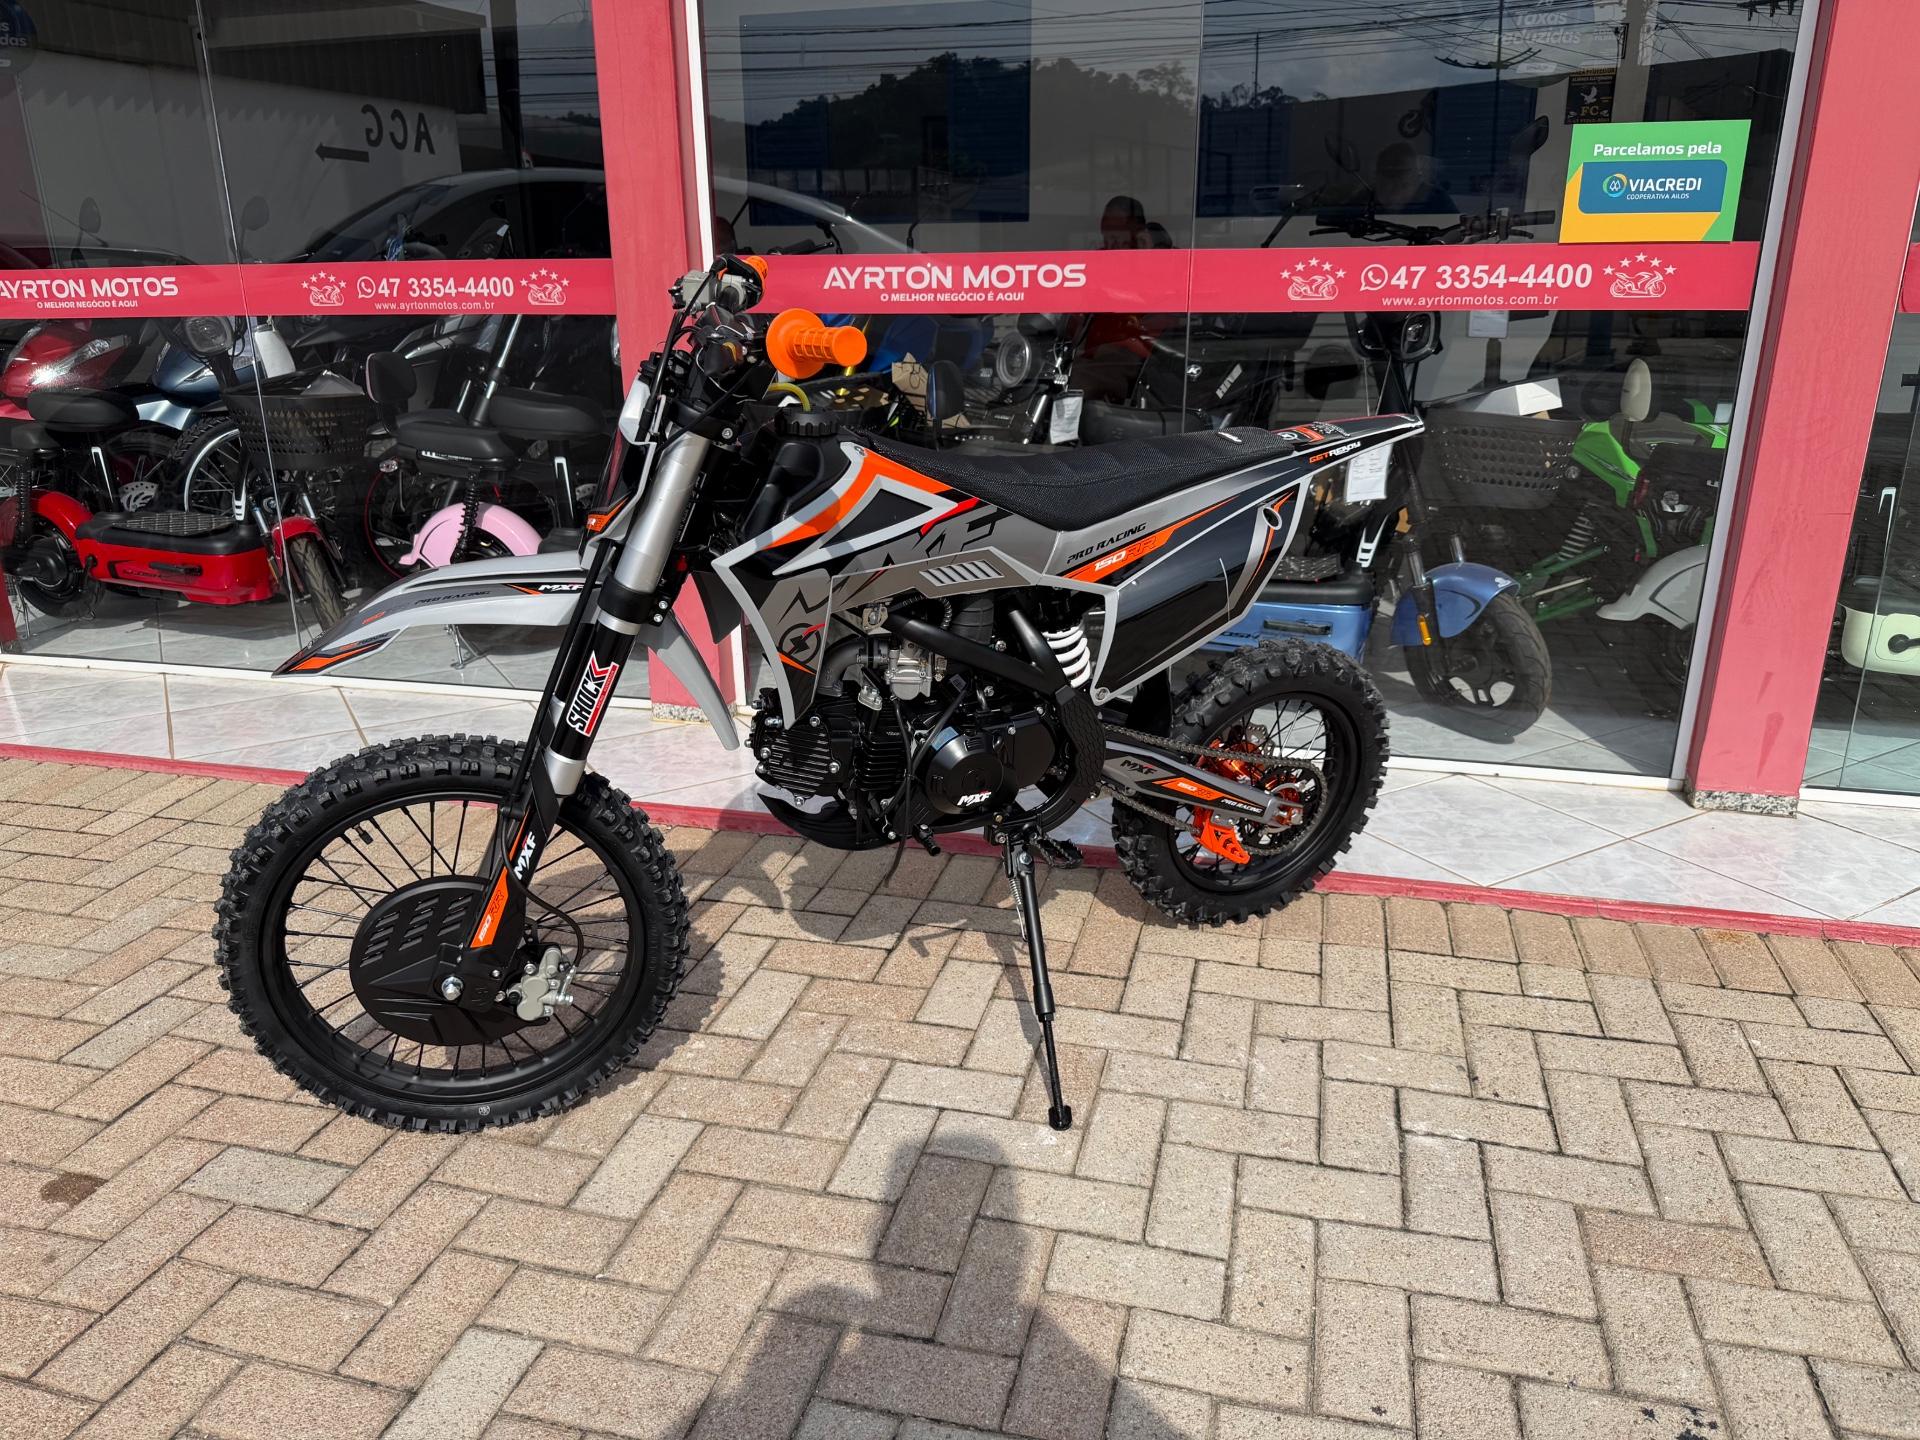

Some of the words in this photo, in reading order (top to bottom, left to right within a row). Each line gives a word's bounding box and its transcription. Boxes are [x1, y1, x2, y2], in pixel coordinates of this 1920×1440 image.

[1515, 11, 1569, 27] Taxas
[1593, 142, 1684, 157] Parcelamos
[1687, 141, 1722, 157] pela
[1629, 177, 1702, 192] VIACREDI
[1626, 193, 1670, 201] COOPERATIVA
[1671, 192, 1690, 200] AILOS
[823, 265, 953, 290] AYRTON
[963, 263, 1087, 289] MOTOS
[1390, 265, 1427, 290] 47
[1435, 263, 1594, 289] 3354-4400
[0, 278, 86, 299] AYRTON
[91, 276, 179, 298] MOTOS
[378, 277, 401, 298] 47
[407, 276, 515, 298] 3354-4400
[37, 301, 43, 309] O
[44, 300, 75, 309] MELHOR
[76, 299, 111, 309] NEGÓCIO
[112, 299, 117, 308] É
[118, 299, 138, 308] AQUI
[880, 292, 889, 302] O
[890, 292, 935, 302] MELHOR
[936, 290, 986, 302] NEGÓCIO
[987, 290, 995, 301] É
[996, 291, 1025, 302] AQUI
[1381, 293, 1559, 308] www.ayrtonmotos.com.br
[375, 300, 495, 311] www.ayrtonmotos.com.br
[1066, 544, 1094, 565] PRO
[1095, 522, 1147, 550] RACING
[538, 583, 586, 592] MXF
[567, 657, 610, 733] SHOCK
[1120, 759, 1158, 776] MXF
[957, 789, 992, 807] MXF
[1235, 801, 1263, 814] RACING
[513, 830, 537, 881] MXF
